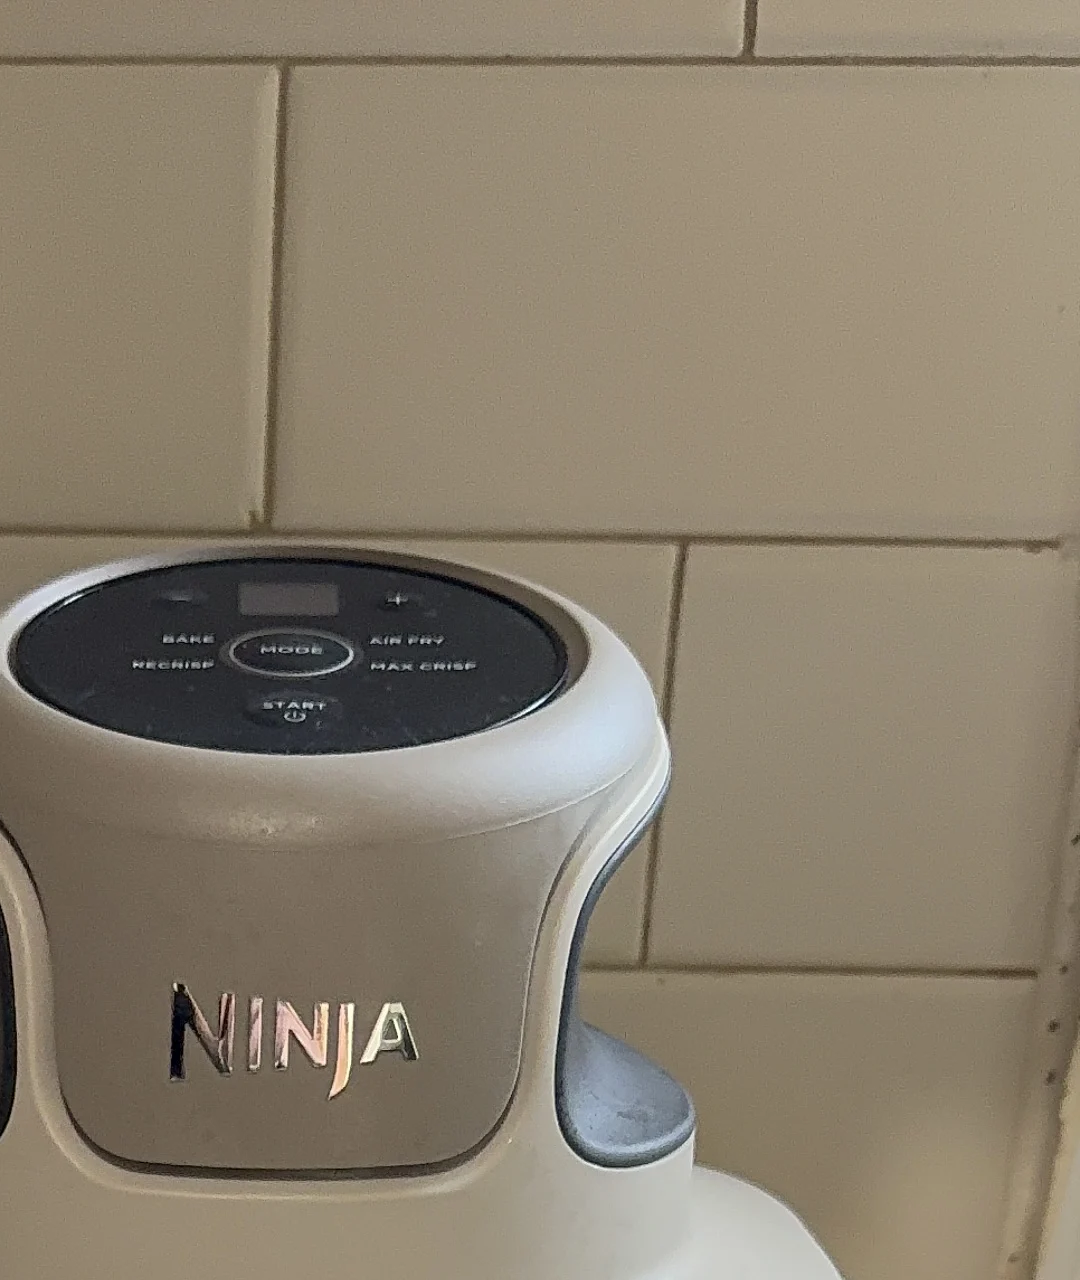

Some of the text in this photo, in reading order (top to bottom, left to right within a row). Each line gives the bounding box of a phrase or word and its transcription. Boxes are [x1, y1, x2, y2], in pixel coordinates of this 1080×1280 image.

[162, 633, 215, 644] BAKE
[369, 633, 445, 645] AIR FRY
[260, 643, 323, 655] MODE
[132, 659, 215, 670] RECRISP
[370, 661, 477, 671] MAX CRISP
[263, 700, 327, 711] START
[170, 981, 419, 1100] NINJA
